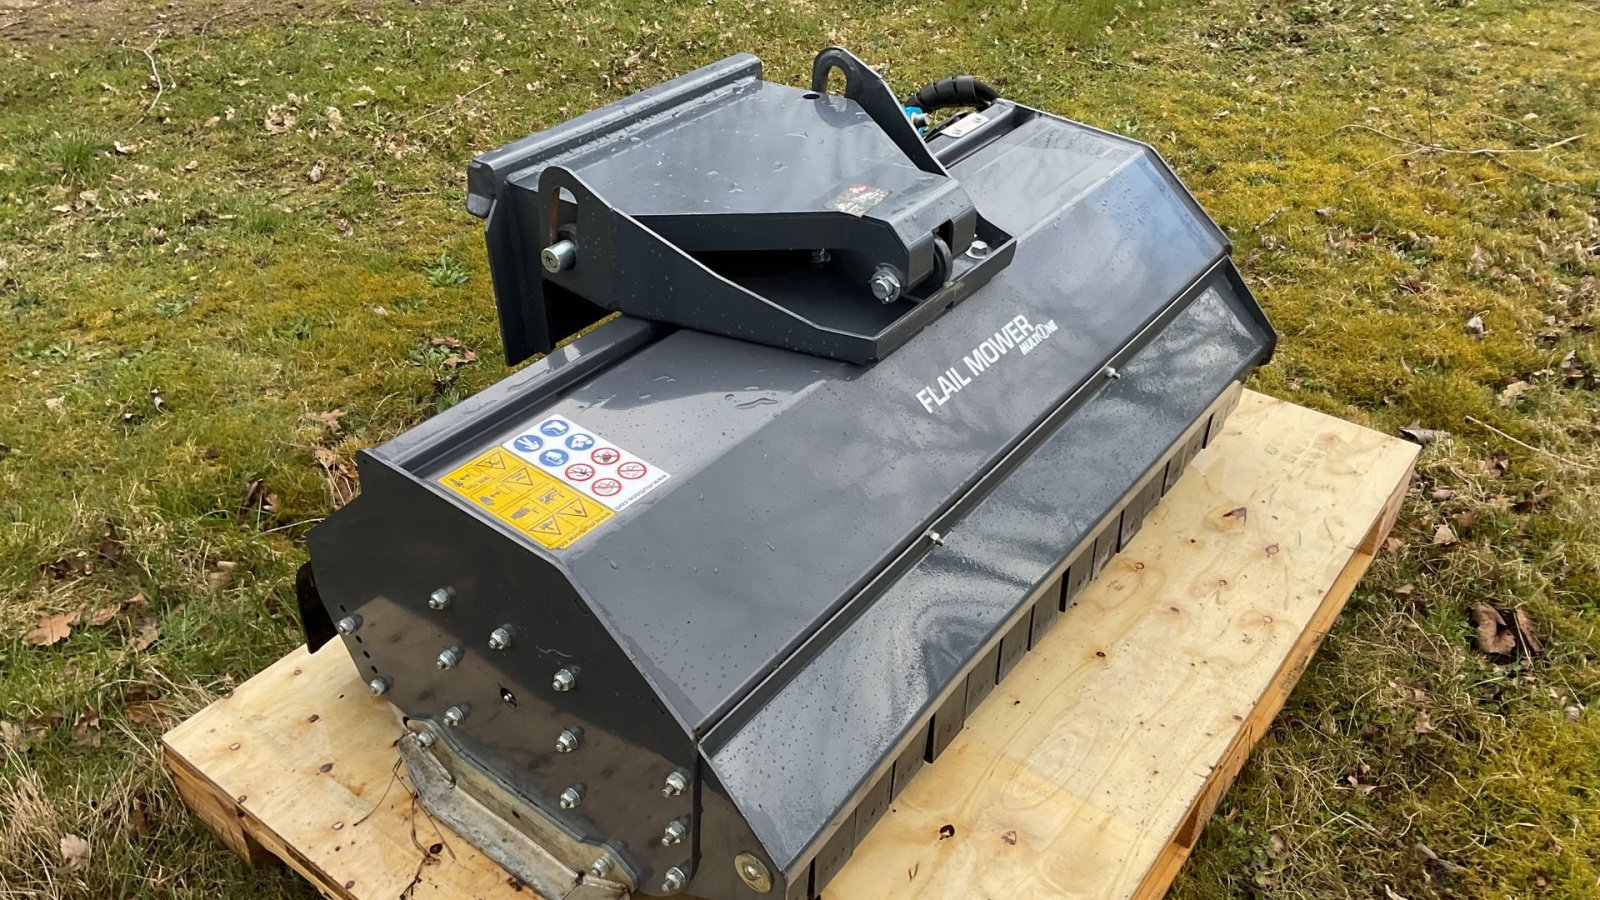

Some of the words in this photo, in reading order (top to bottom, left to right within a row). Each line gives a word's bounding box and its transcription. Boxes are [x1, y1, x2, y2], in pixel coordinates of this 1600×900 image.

[915, 366, 972, 414] FLAIL
[963, 313, 1035, 376] MOWER
[614, 474, 668, 511] www.multione.com
[557, 511, 612, 548] www.multione.co
